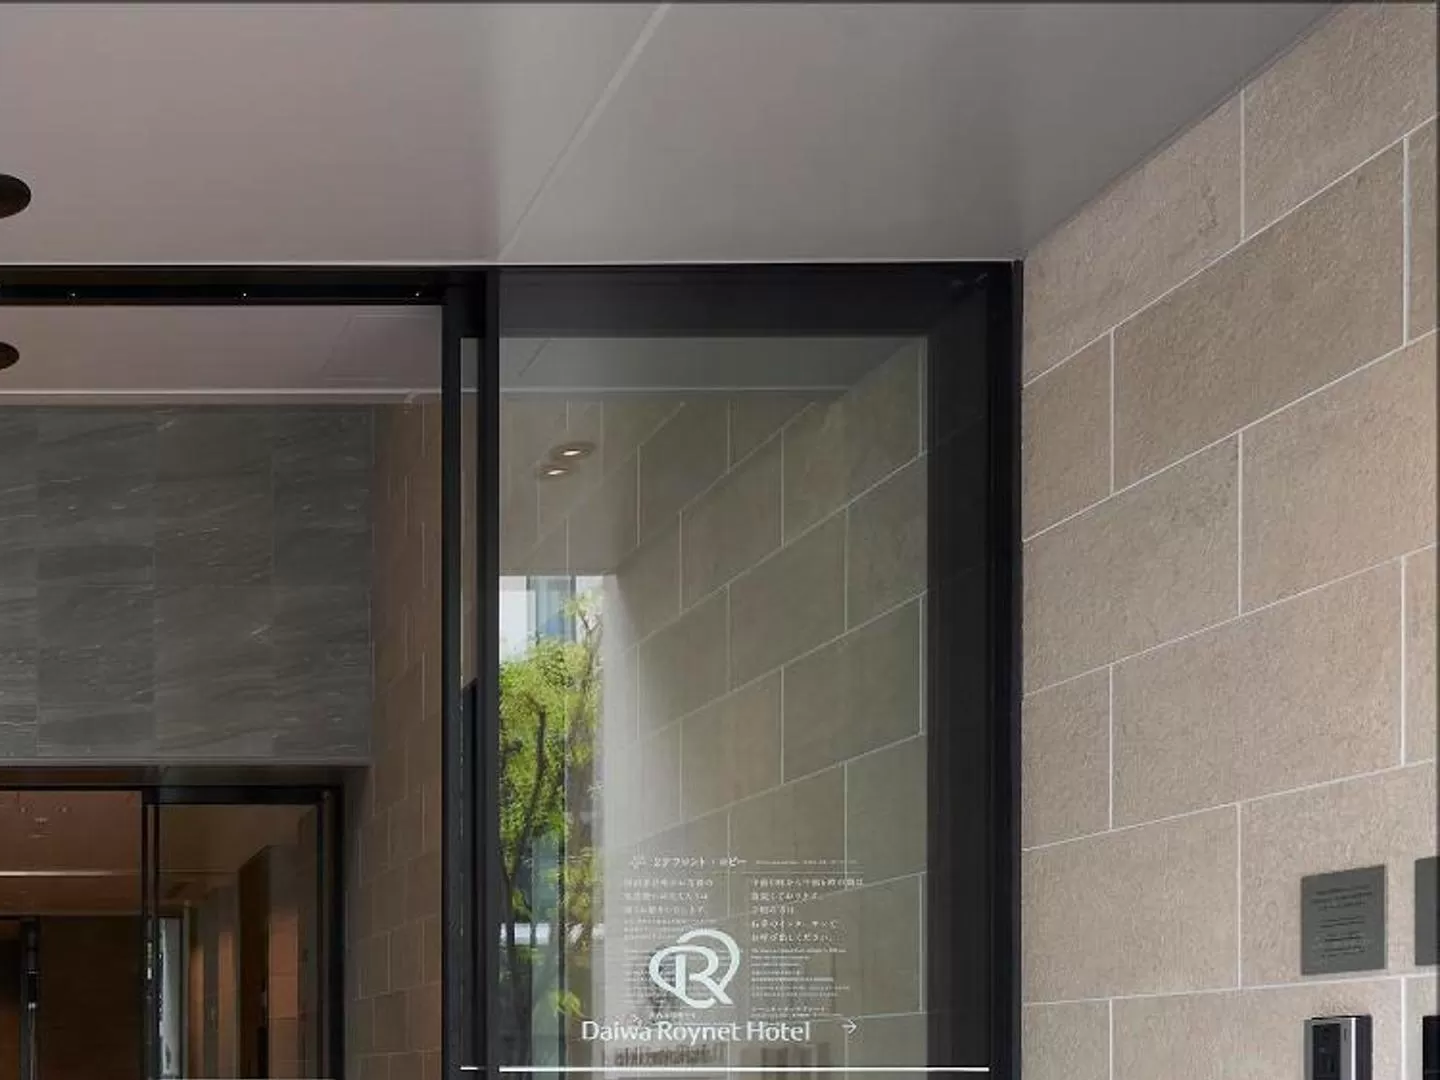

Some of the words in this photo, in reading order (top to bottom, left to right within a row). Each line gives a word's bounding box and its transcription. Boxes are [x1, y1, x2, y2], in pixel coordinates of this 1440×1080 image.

[581, 1021, 652, 1042] Daiwa
[659, 1021, 739, 1045] Roynet
[747, 1021, 811, 1042] Hotel
